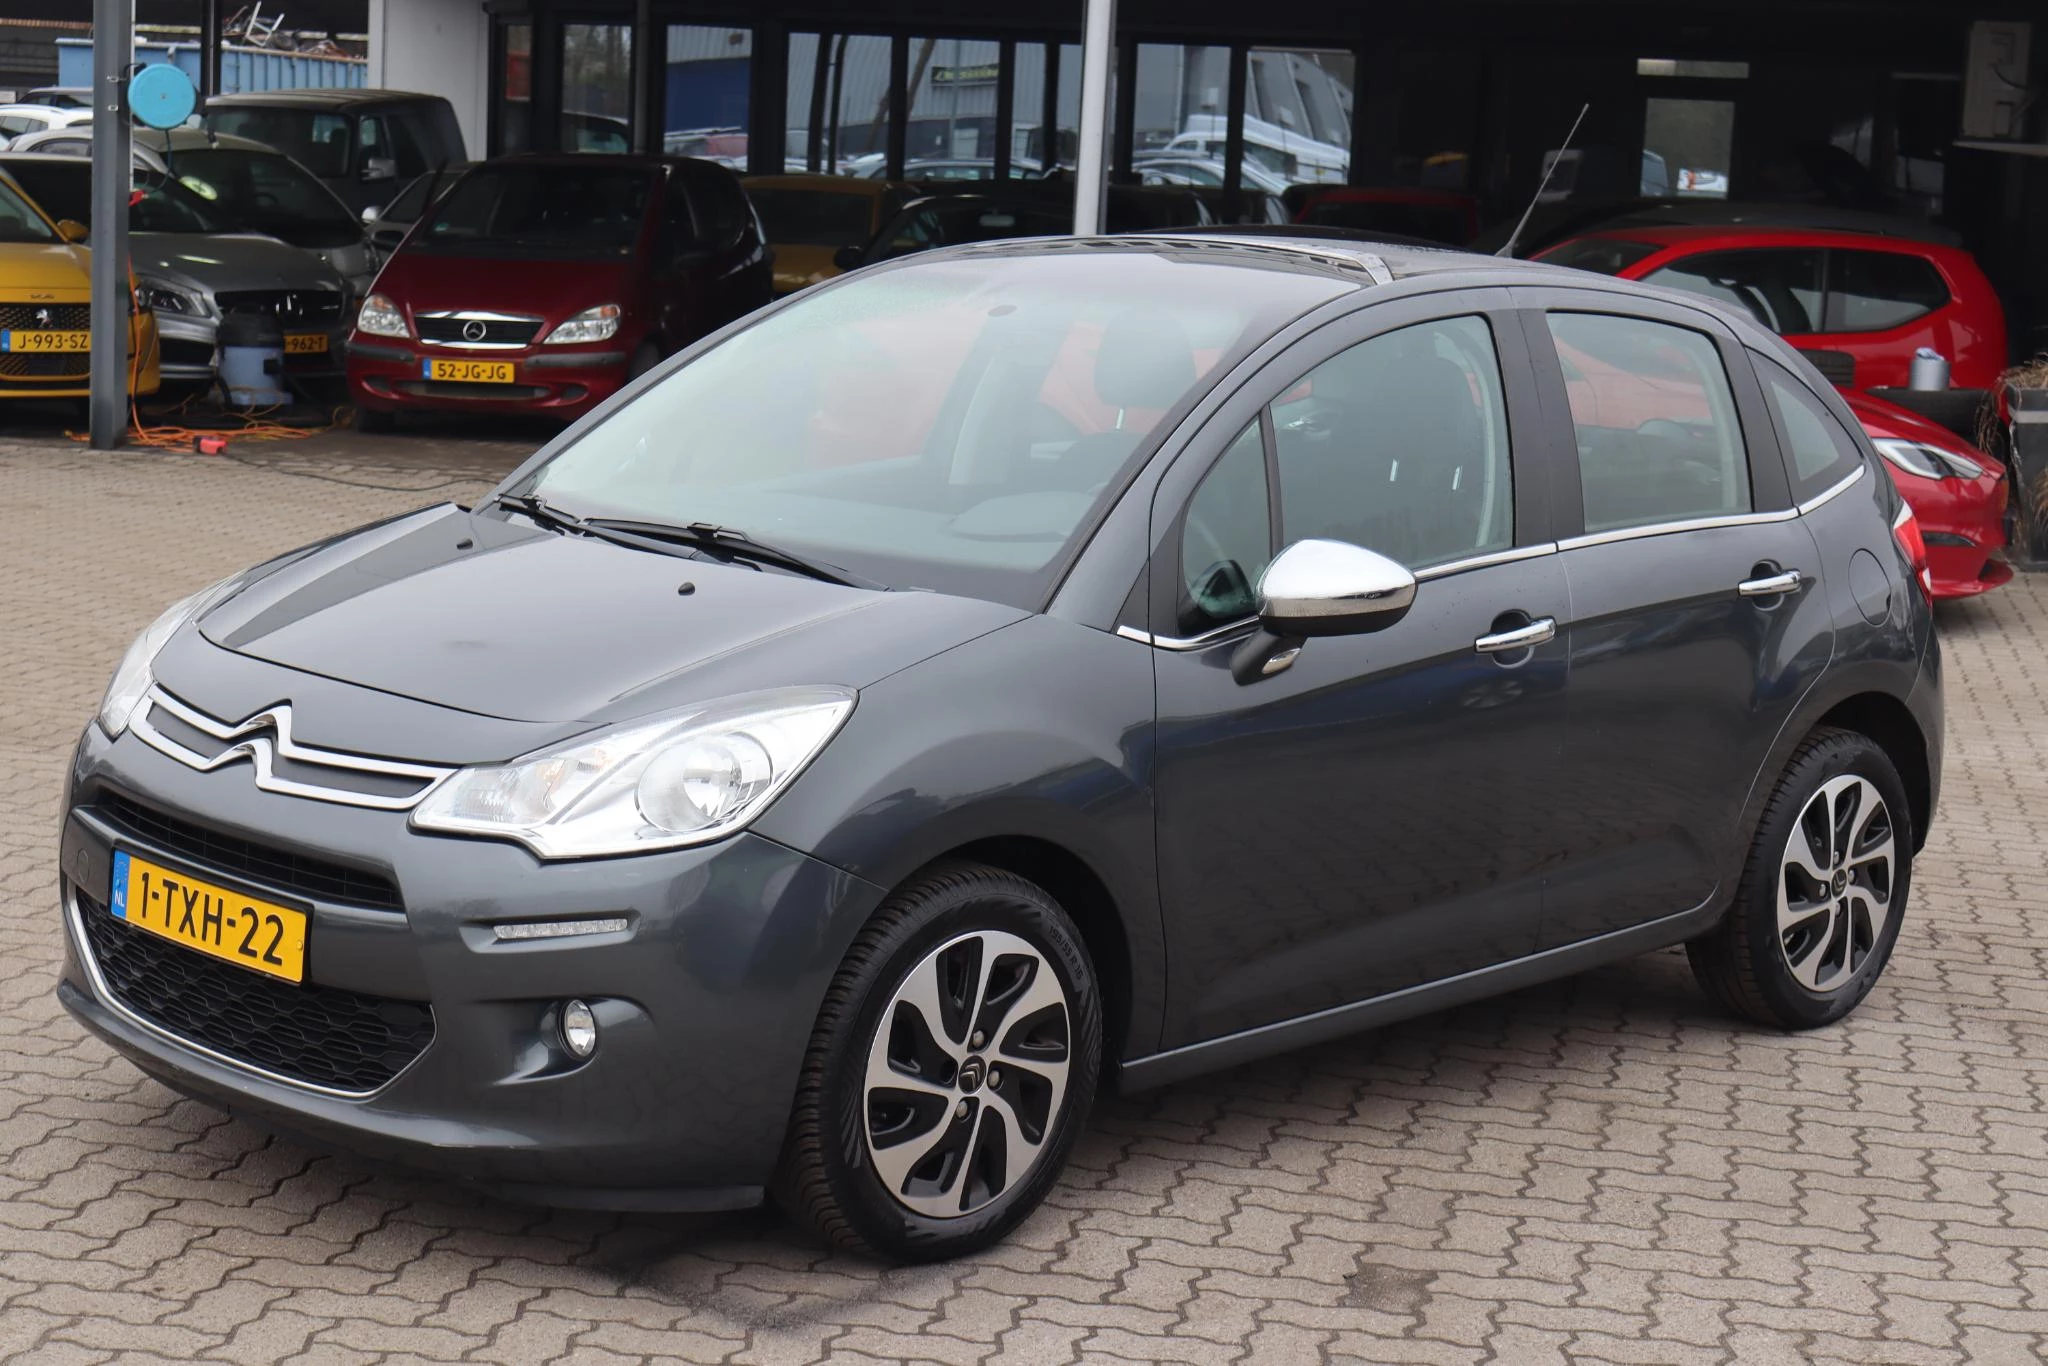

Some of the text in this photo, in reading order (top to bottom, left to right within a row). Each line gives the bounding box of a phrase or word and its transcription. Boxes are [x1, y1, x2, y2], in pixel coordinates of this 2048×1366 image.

[18, 333, 89, 349] J-993-SZ
[286, 336, 326, 351] -962-T
[437, 363, 507, 379] 52-JG-JG
[114, 889, 125, 908] NL
[141, 871, 284, 967] 1-TXH-22
